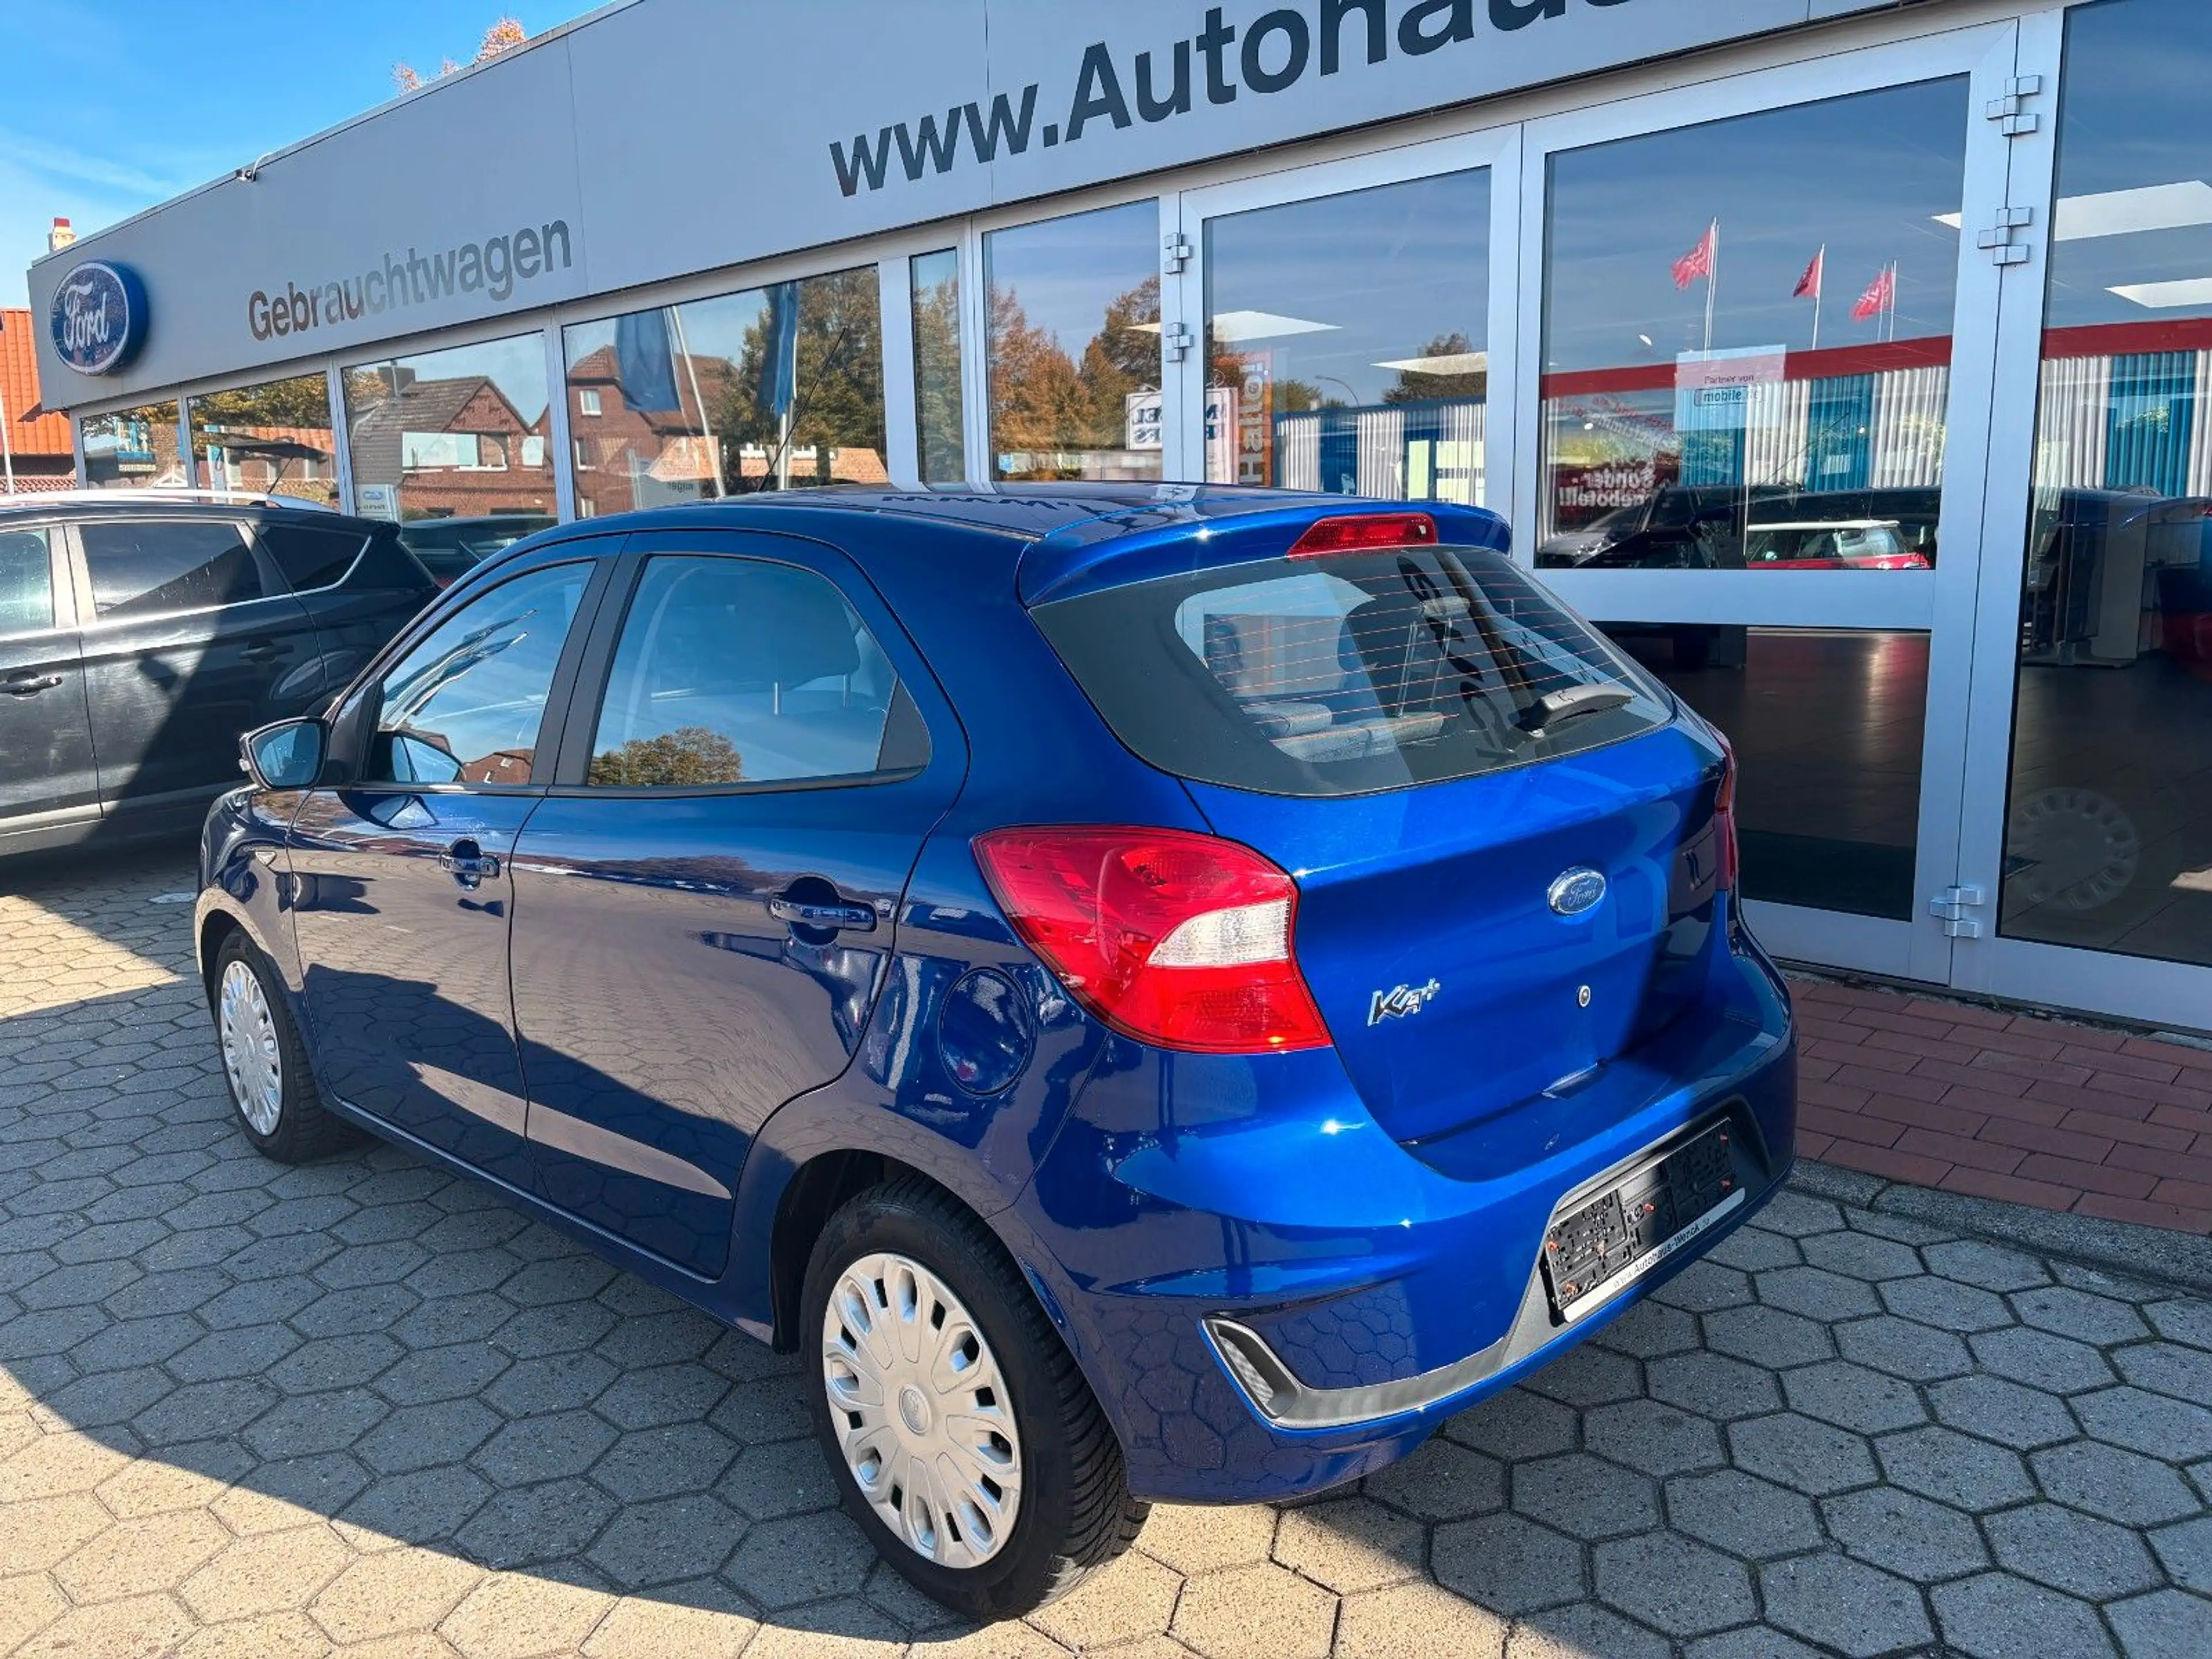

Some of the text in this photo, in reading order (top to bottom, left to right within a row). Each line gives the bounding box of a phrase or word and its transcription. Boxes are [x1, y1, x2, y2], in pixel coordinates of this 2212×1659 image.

[828, 0, 1631, 198] www.Autoha
[63, 281, 110, 351] Ford
[249, 219, 572, 342] Gebrauchtwagen
[1566, 878, 1597, 908] Ford
